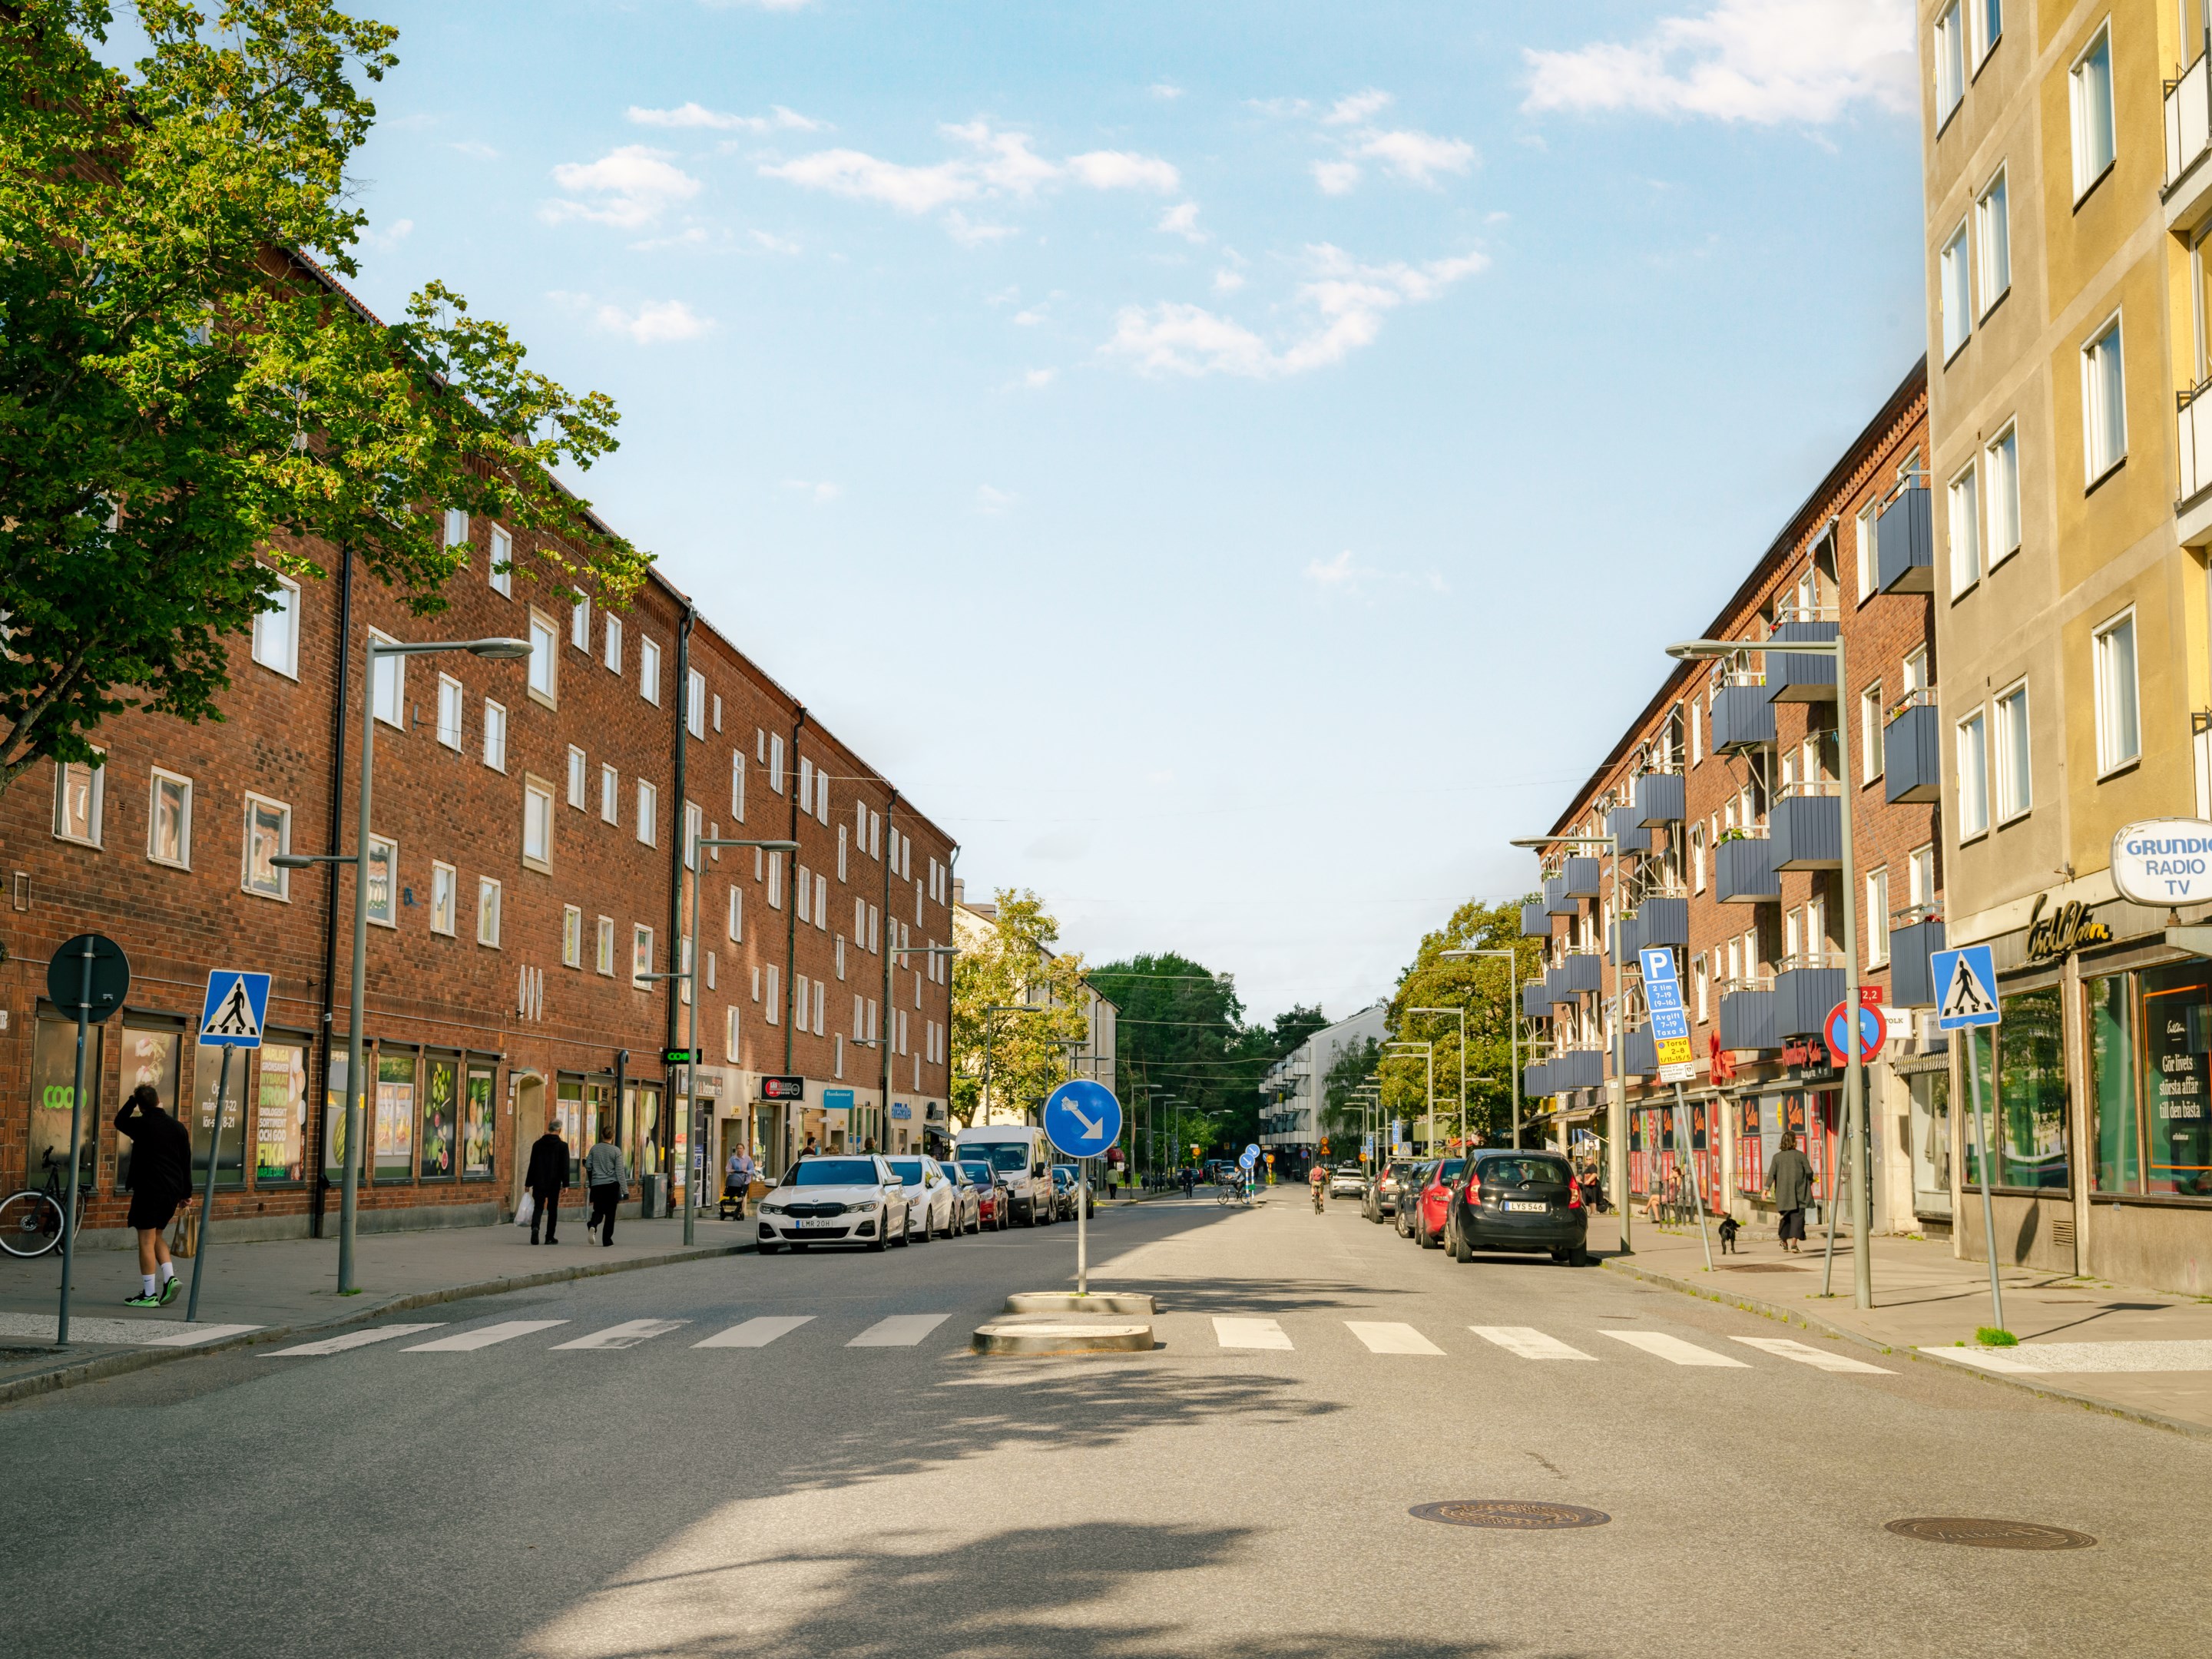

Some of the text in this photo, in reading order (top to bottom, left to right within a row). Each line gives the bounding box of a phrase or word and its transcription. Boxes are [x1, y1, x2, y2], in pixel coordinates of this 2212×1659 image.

[2126, 838, 2212, 856] GRUNDI
[2146, 859, 2206, 876] RADIO
[2164, 879, 2190, 896] TV
[1648, 952, 1667, 979] P
[1654, 998, 1676, 1008] (9-16)
[1863, 990, 1878, 1001] 2,2
[1655, 1012, 1681, 1022] Avgift
[1660, 1054, 1690, 1063] 1/11-15/5
[2162, 1053, 2194, 1073] Gör livets
[261, 1072, 289, 1084] NYBAKAT
[2159, 1075, 2200, 1096] största affär
[211, 1080, 230, 1098] Öpt
[260, 1084, 288, 1107] BRÖD
[224, 1099, 237, 1111] 7-22
[2159, 1099, 2201, 1119] till den bästa
[222, 1116, 235, 1128] 8-21
[259, 1118, 287, 1128] SORTIMENT
[259, 1128, 286, 1142] OCH GOD
[258, 1143, 285, 1166] FIKA
[257, 1167, 273, 1177] VARJE
